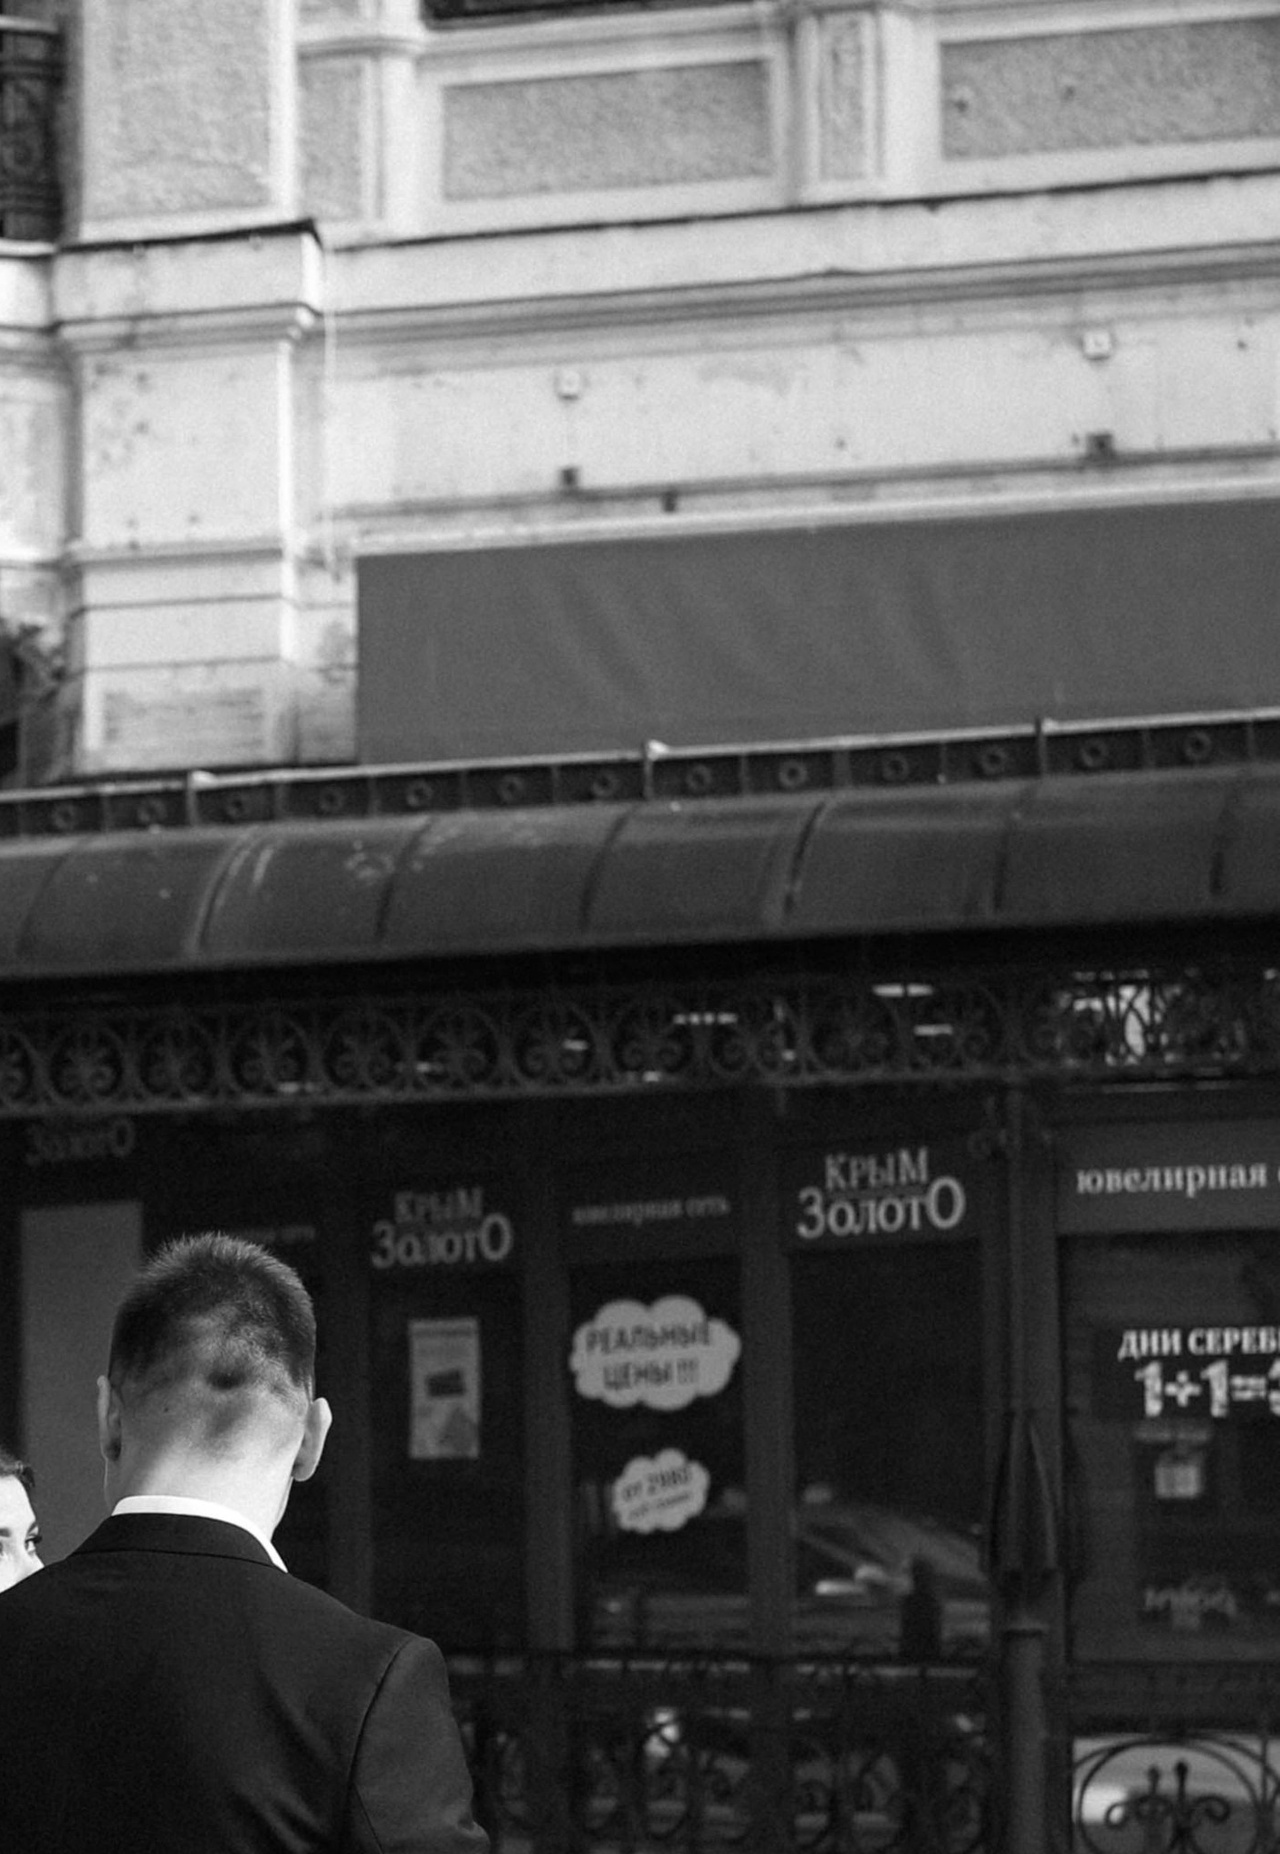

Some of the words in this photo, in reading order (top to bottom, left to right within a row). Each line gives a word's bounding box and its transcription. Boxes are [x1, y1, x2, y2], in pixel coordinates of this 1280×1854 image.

[825, 1147, 929, 1191] КРЫМ
[1076, 1163, 1267, 1198] ювелирная
[394, 1187, 483, 1224] КРЫМ
[586, 1322, 710, 1354] РЕАЛЬНЫЕ
[1118, 1328, 1182, 1361] ДНИ
[1187, 1326, 1280, 1356] СЕРЕБ
[603, 1361, 673, 1390] ЦЕНЫ
